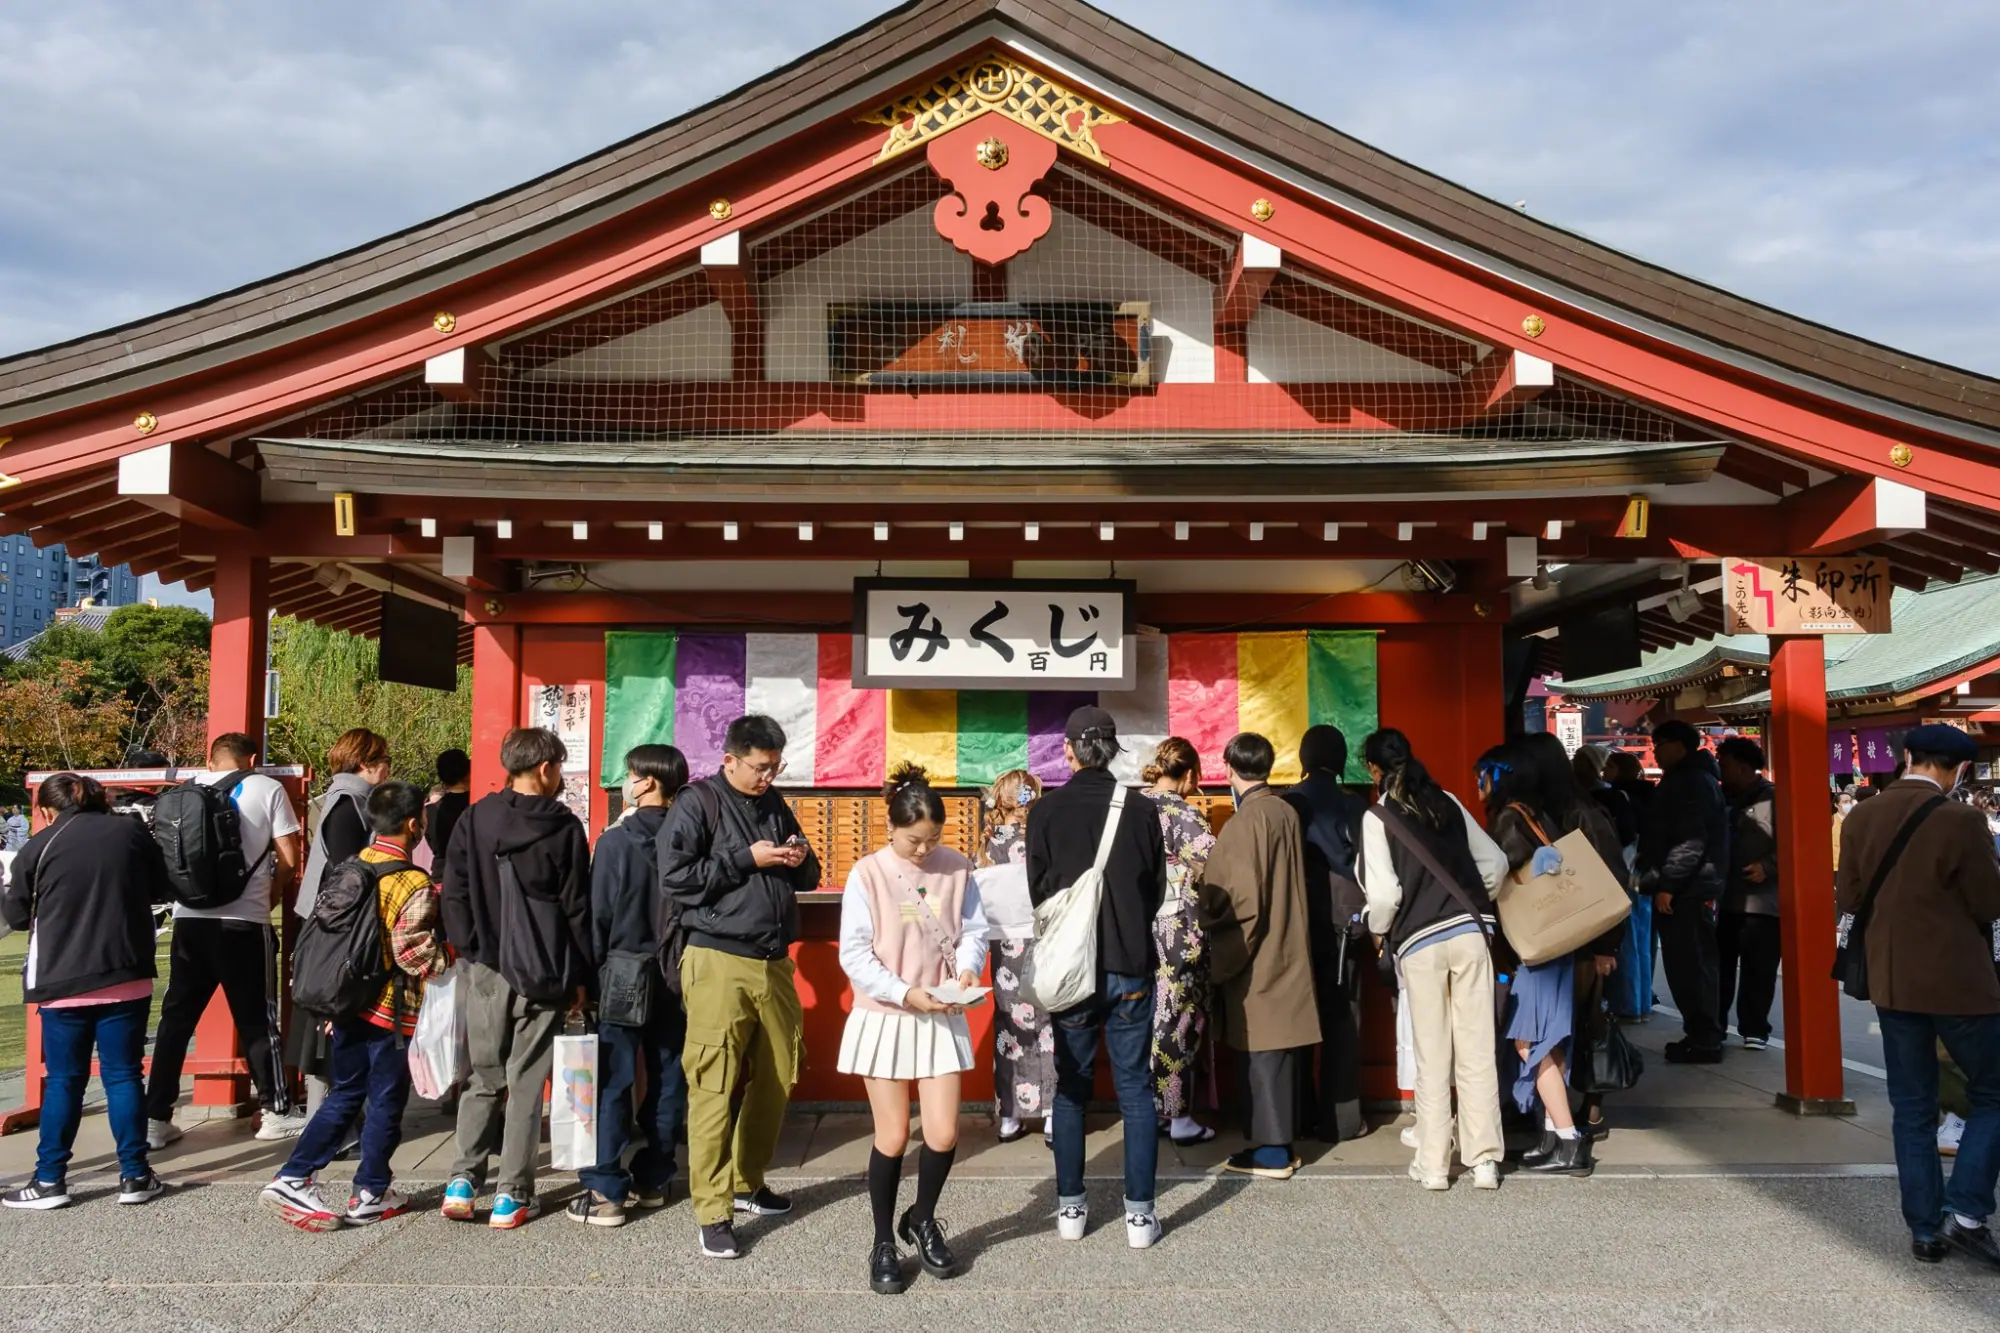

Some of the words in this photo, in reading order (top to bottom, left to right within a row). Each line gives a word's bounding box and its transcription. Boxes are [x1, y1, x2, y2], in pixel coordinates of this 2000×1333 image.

[1735, 580, 1749, 629] この先左
[1780, 560, 1882, 605] 朱印所
[889, 600, 1100, 662] みくじ
[565, 692, 577, 731] 酉の市
